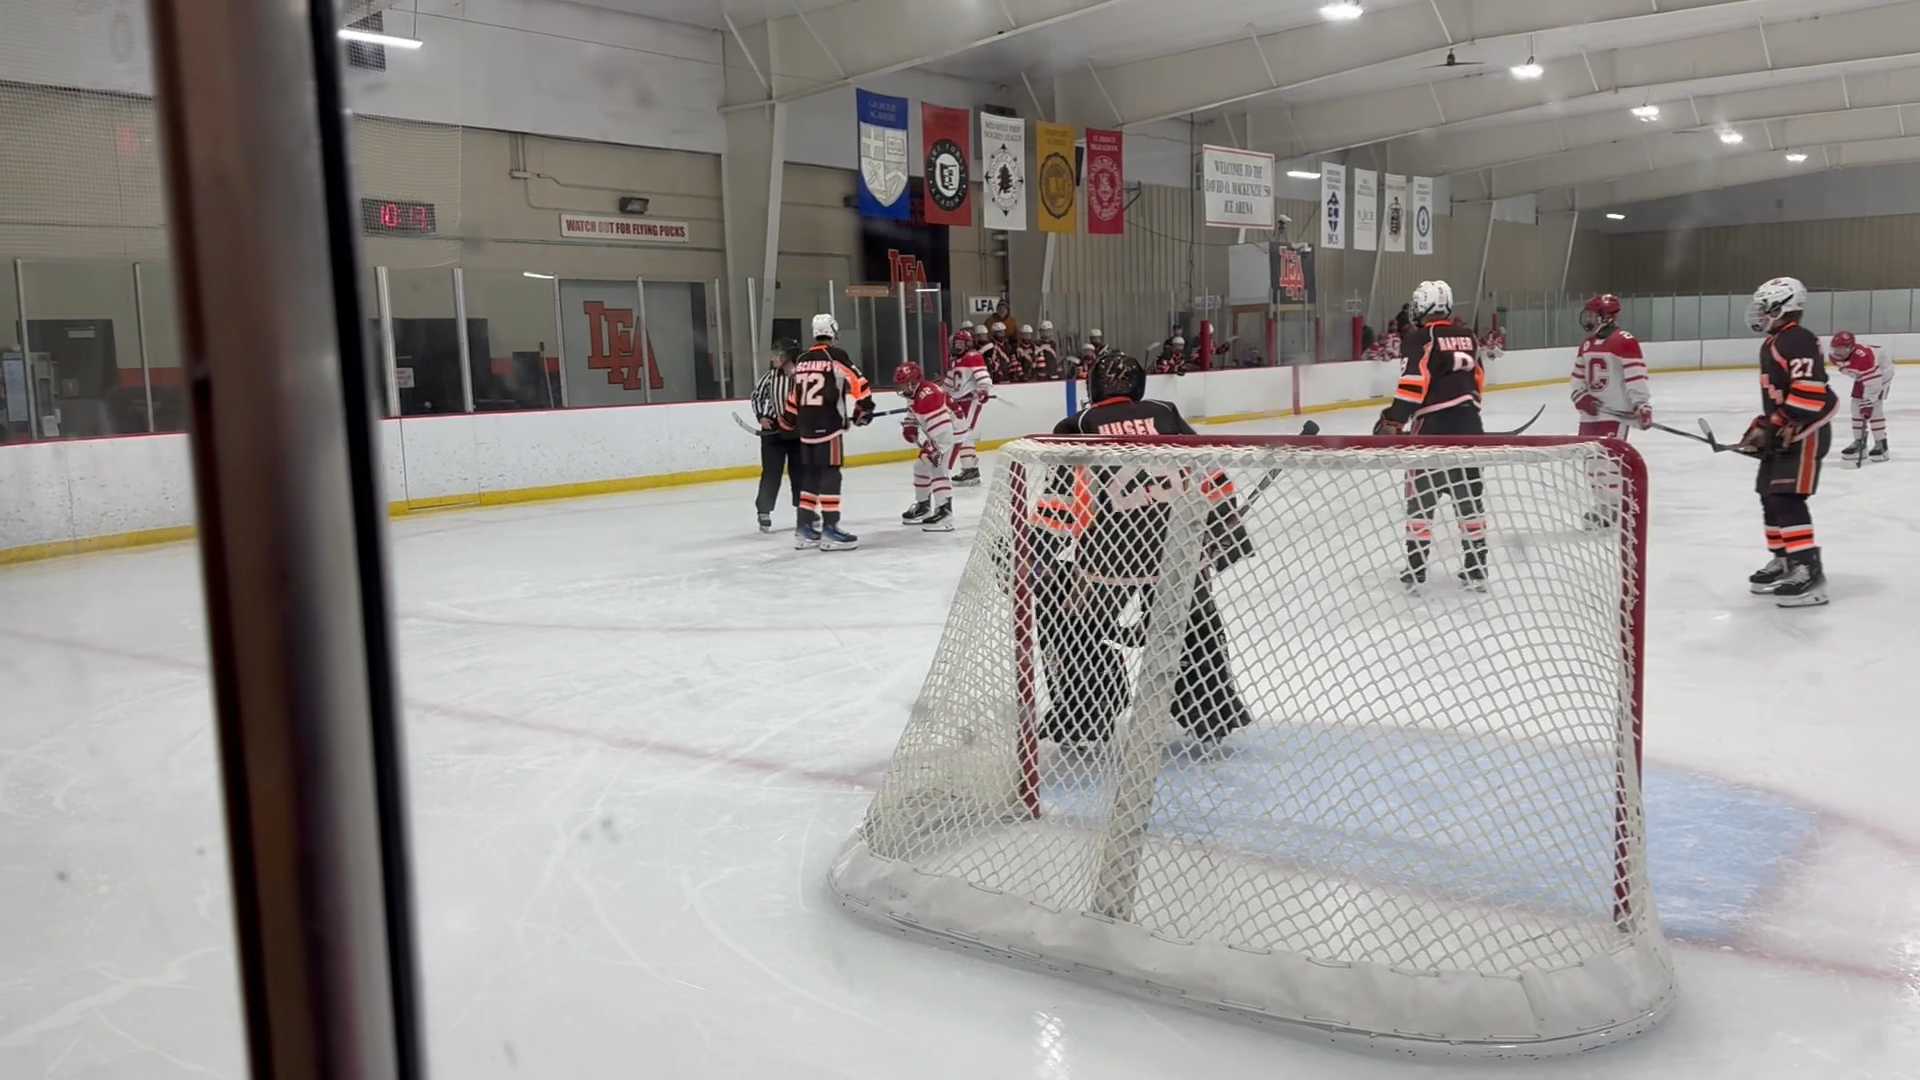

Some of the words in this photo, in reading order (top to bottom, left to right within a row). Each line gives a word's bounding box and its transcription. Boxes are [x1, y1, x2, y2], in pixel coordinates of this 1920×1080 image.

[1214, 160, 1243, 176] WELCOME
[1244, 164, 1252, 177] TO
[1253, 165, 1263, 178] THE
[1205, 179, 1224, 193] DAVID
[1224, 200, 1233, 213] ICE
[1235, 201, 1253, 214] ARENA
[566, 219, 597, 233] WATCH
[598, 221, 615, 234] OUT
[616, 223, 632, 235] FOR
[632, 223, 658, 236] FLYING
[659, 225, 686, 238] PUCKS
[975, 299, 995, 312] LFA
[583, 300, 664, 391] LFA
[1588, 357, 1609, 392] C
[1789, 357, 1815, 378] 27
[1098, 417, 1159, 435] HUSEK
